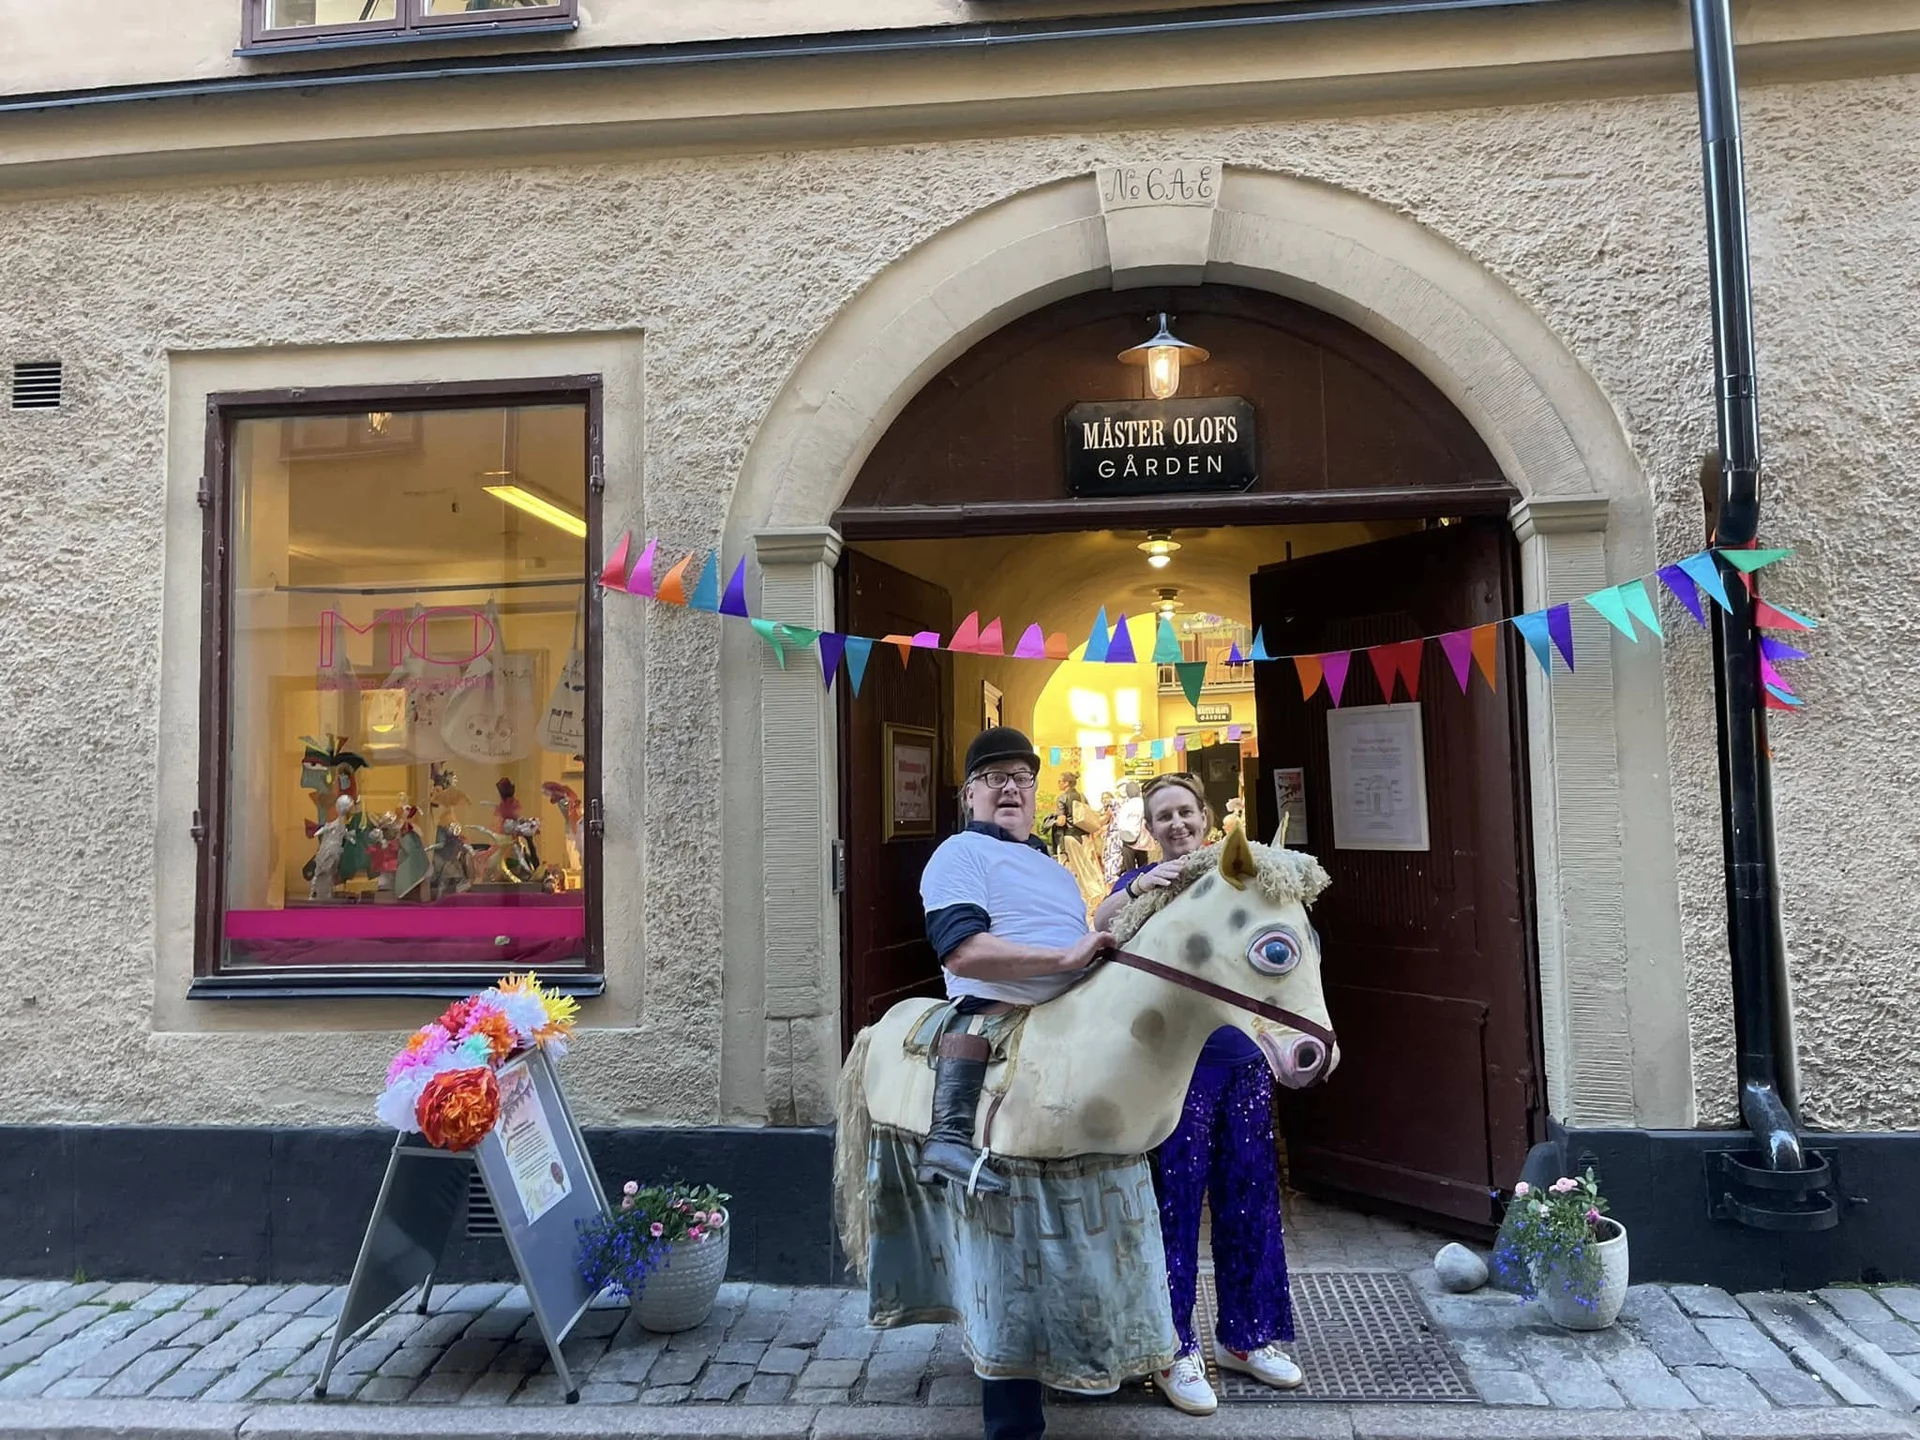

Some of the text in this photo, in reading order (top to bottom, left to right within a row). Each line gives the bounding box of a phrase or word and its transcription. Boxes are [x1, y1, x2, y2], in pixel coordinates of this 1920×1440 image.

[1082, 416, 1238, 450] MÄSTER OLOFS
[1098, 454, 1222, 478] GÅRDEN
